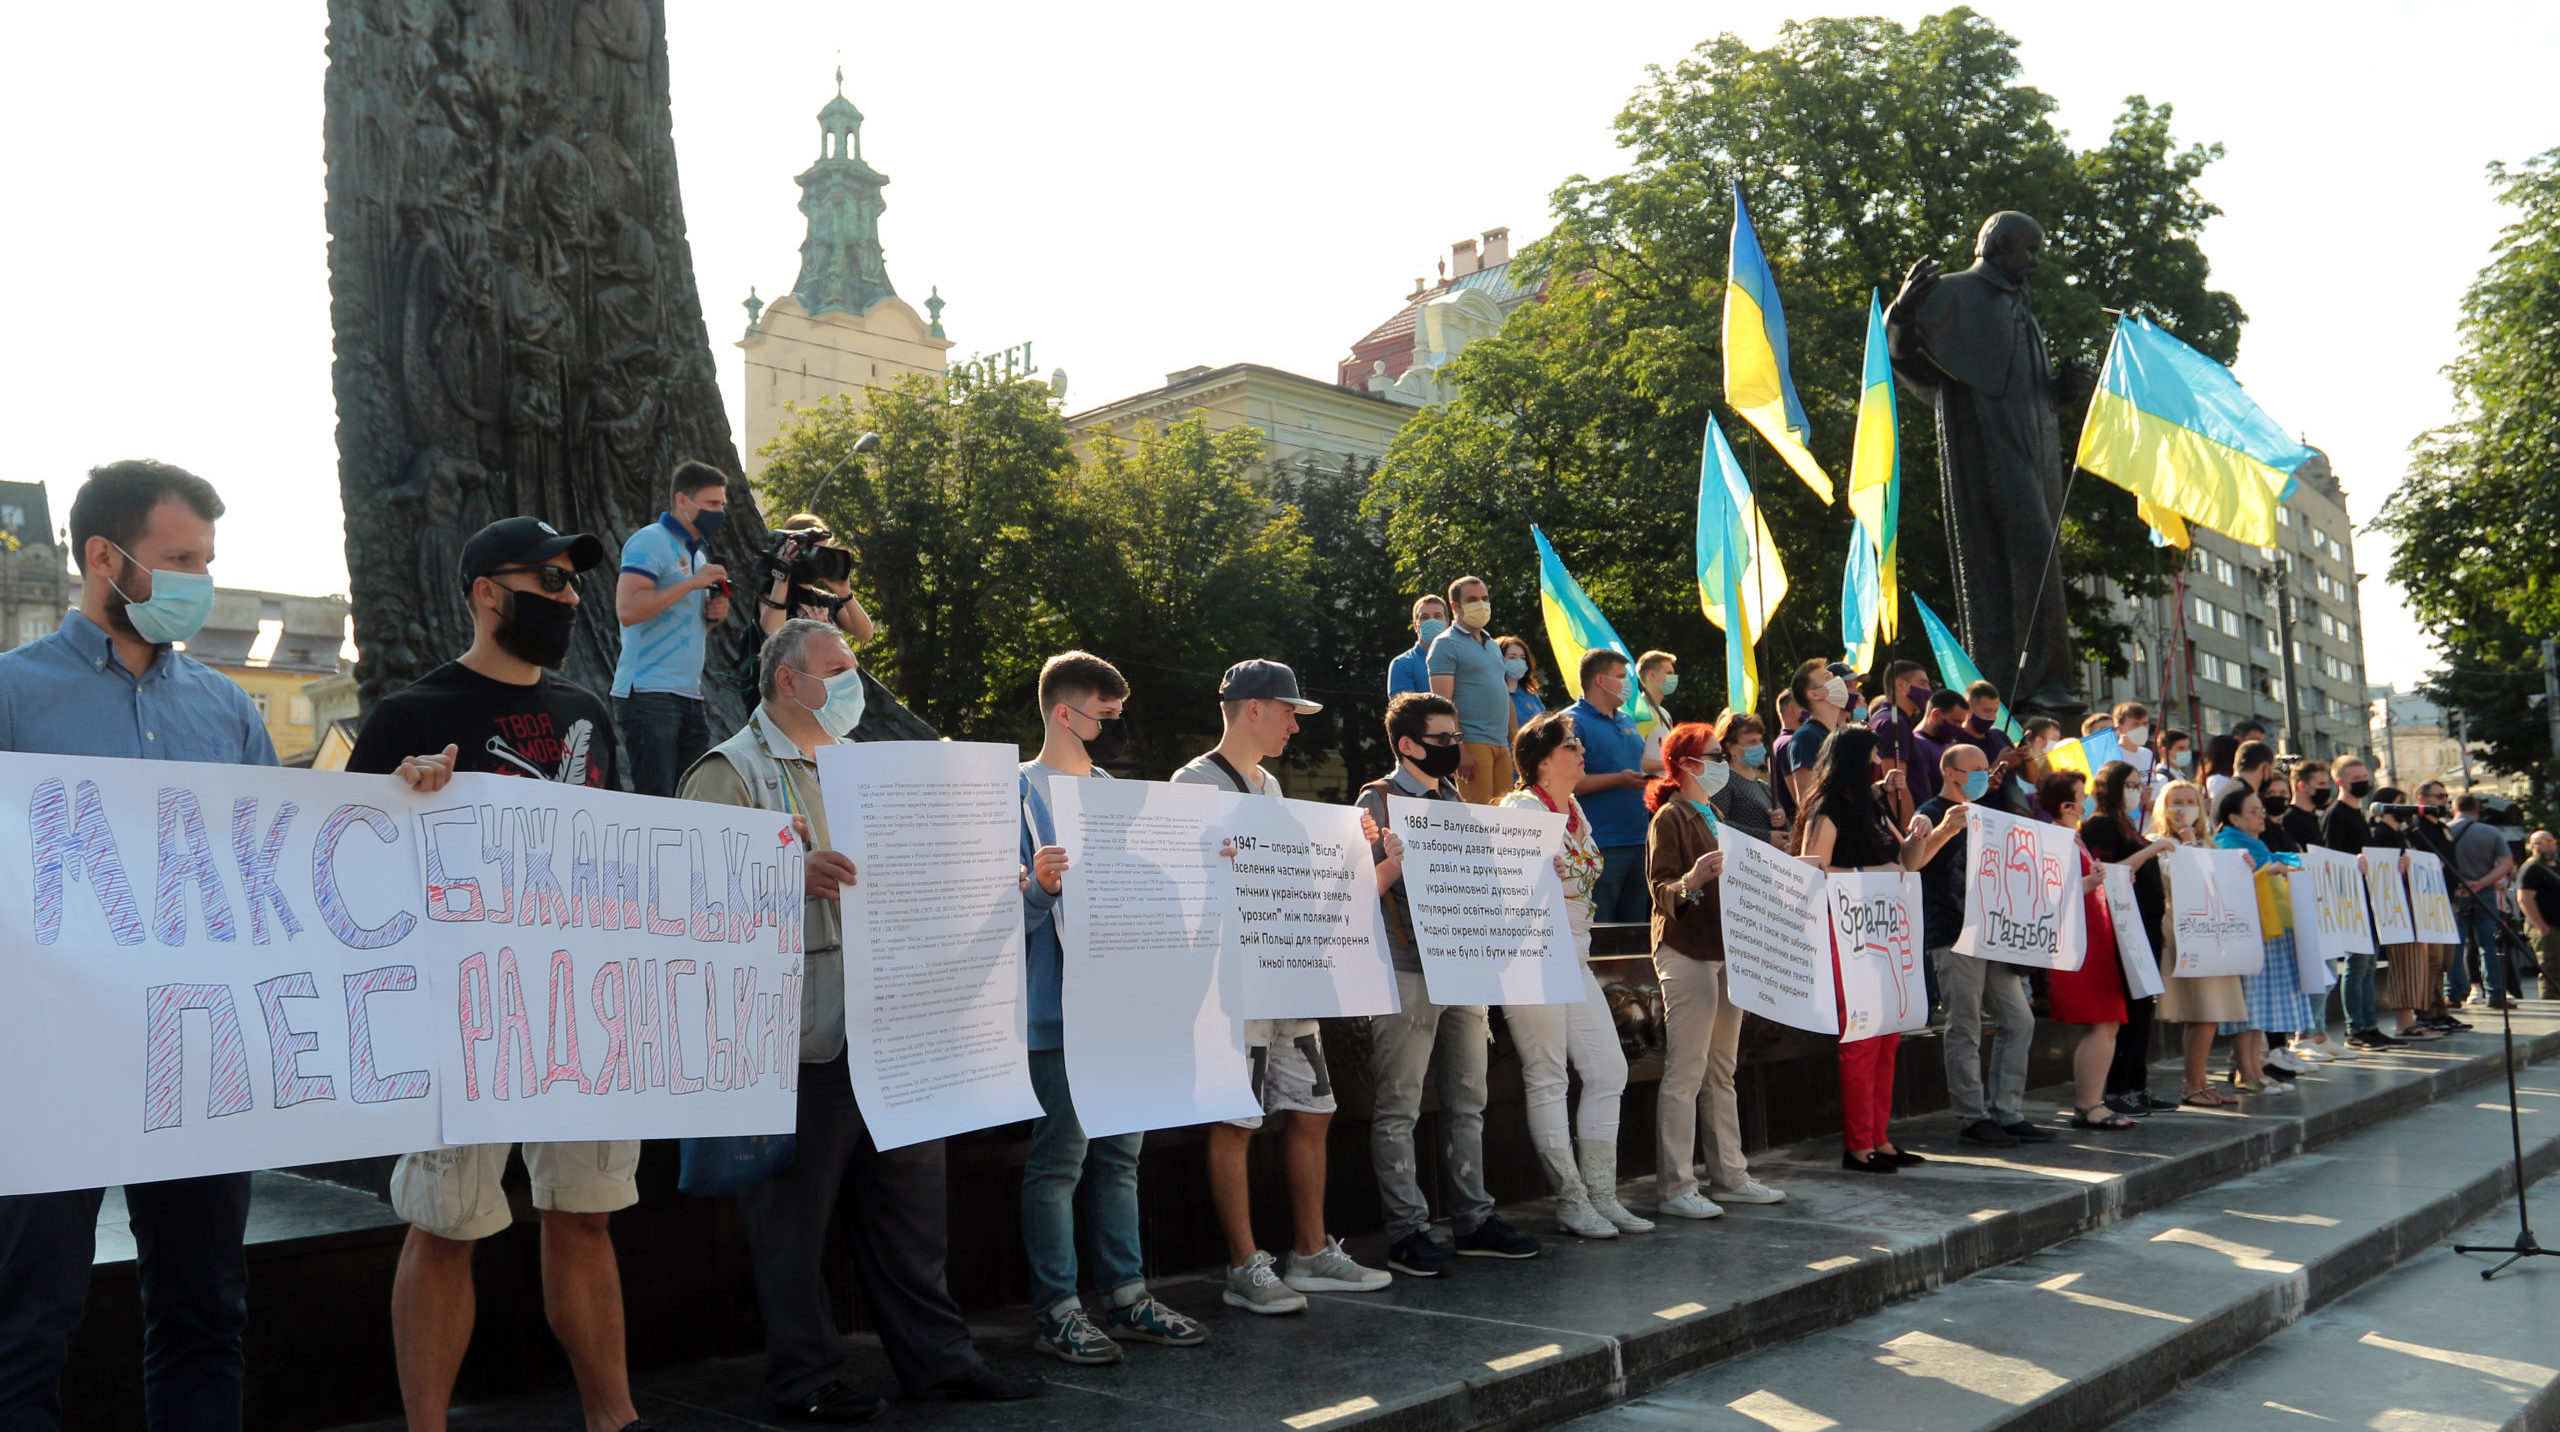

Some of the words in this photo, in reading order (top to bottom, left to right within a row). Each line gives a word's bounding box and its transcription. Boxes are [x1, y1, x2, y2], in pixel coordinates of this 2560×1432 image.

[494, 713, 554, 739] ТВОЯ
[517, 738, 573, 763] МОВА
[1404, 815, 1428, 830] 1863
[1444, 818, 1500, 835] Валуєвський
[1502, 826, 1542, 839] циркуляр
[1233, 835, 1257, 851] 1947
[1272, 843, 1310, 856] операція
[1422, 839, 1463, 855] заборону
[1465, 844, 1495, 856] давати
[1497, 844, 1542, 859] цензурний
[29, 777, 418, 950] МАКС
[419, 802, 803, 955] БУЖАНСЬКИЙ
[1429, 860, 1458, 874] дозвіл
[1460, 864, 1471, 875] на
[1472, 865, 1523, 878] друкування
[1745, 847, 1762, 863] 1876
[1769, 859, 1792, 878] Емський
[1277, 866, 1311, 878] частини
[1312, 867, 1349, 882] українців
[1739, 861, 1772, 885] Олександра
[1272, 887, 1321, 903] українських
[1323, 891, 1352, 903] земель
[1425, 881, 1489, 896] україномовної
[1491, 884, 1530, 897] духовної
[1727, 875, 1761, 895] друкування
[1284, 909, 1301, 923] між
[1303, 911, 1343, 924] поляками
[1345, 915, 1350, 927] у
[1463, 904, 1503, 917] освітньої
[1838, 887, 1900, 952] Зрада
[1262, 932, 1294, 947] Польщі
[1296, 934, 1312, 947] для
[1313, 935, 1370, 949] прискорення
[1452, 924, 1488, 938] окремої
[1489, 924, 1554, 939] малоросійської
[1987, 907, 2059, 954] Ґаньба
[1427, 946, 1445, 958] мови
[1446, 947, 1457, 957] не
[1459, 945, 1479, 960] було
[1486, 945, 1506, 960] бути
[1508, 947, 1518, 958] не
[1258, 955, 1286, 969] їхньої
[1286, 956, 1336, 971] полонізації.
[144, 965, 431, 1133] ПЕС
[459, 946, 801, 1102] РАДЯНСЬКИЙ
